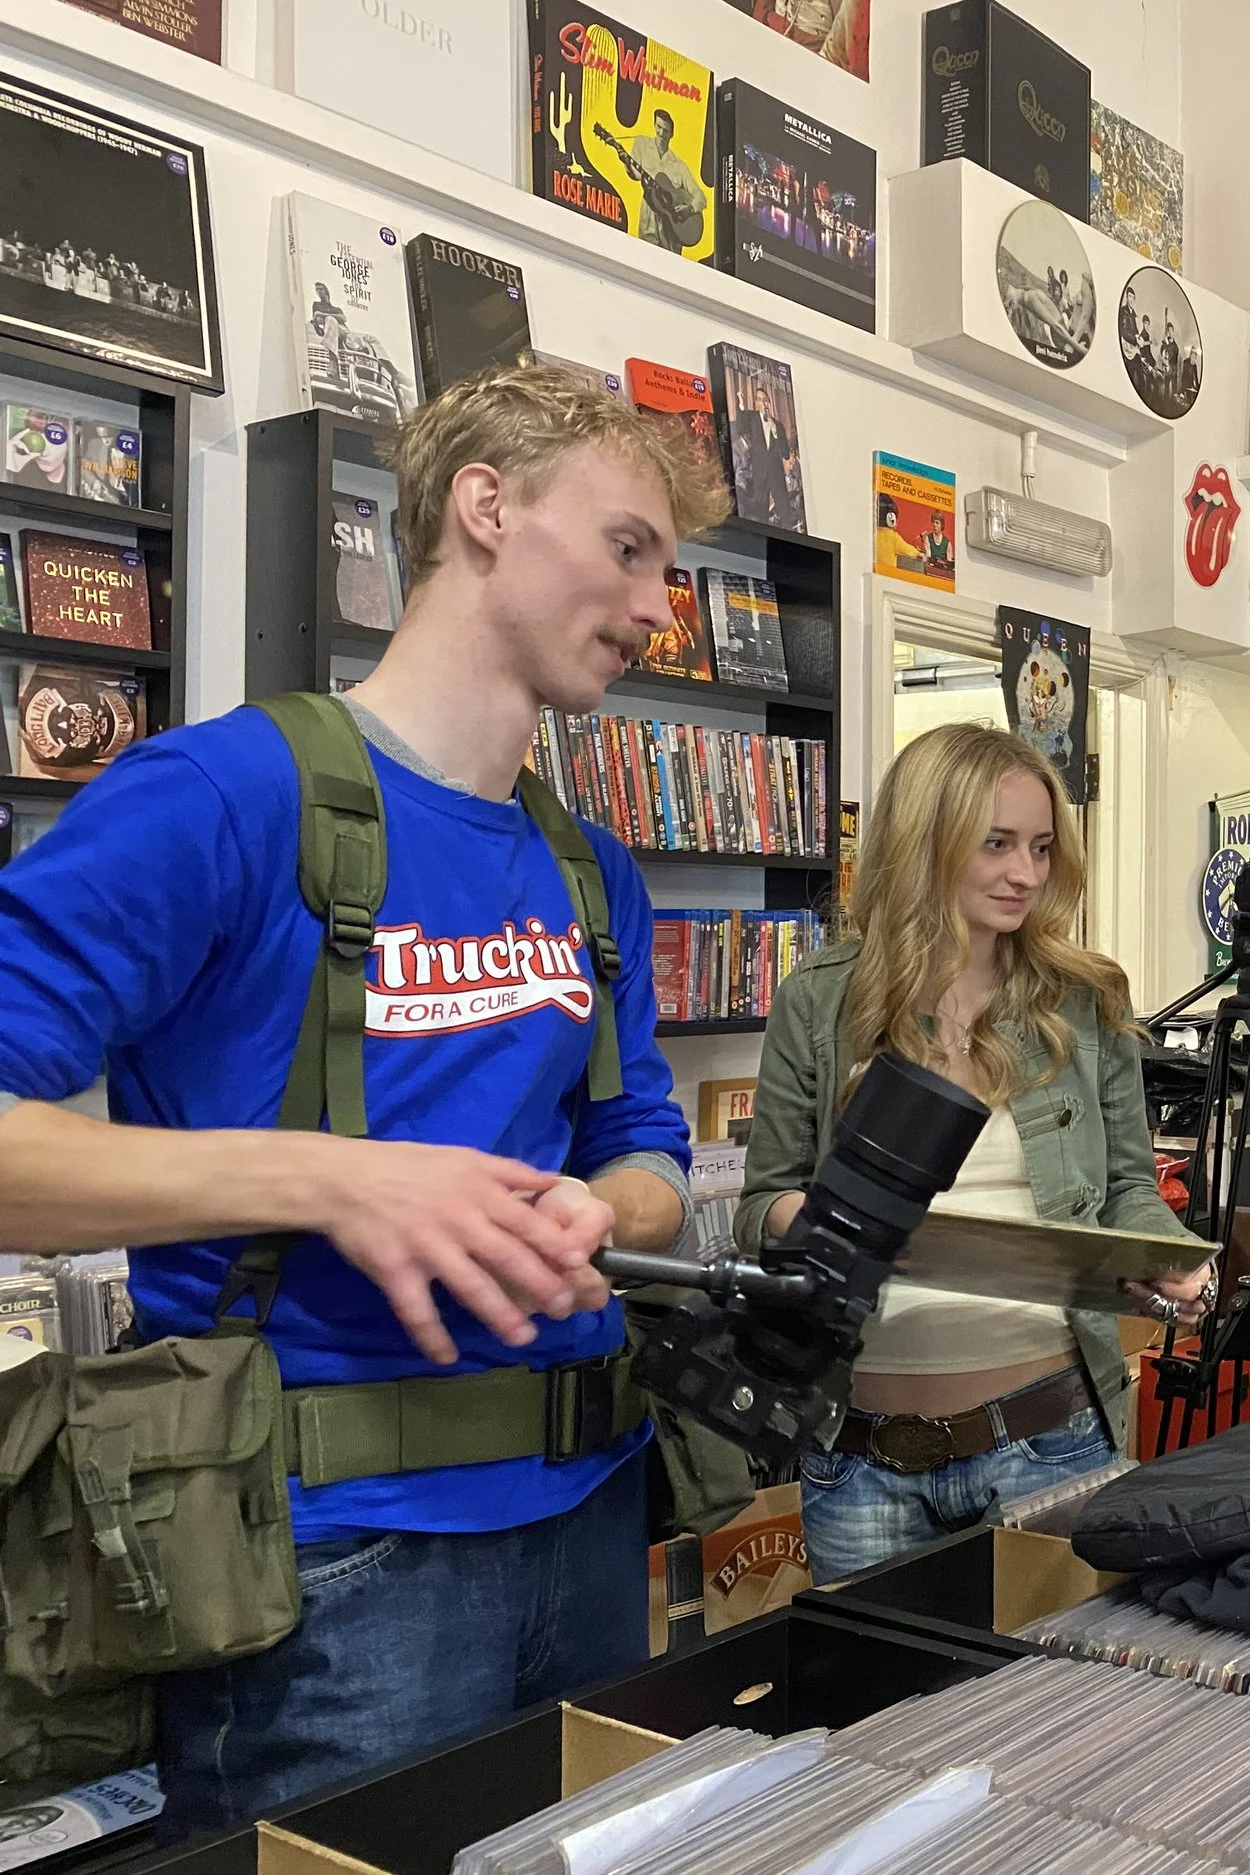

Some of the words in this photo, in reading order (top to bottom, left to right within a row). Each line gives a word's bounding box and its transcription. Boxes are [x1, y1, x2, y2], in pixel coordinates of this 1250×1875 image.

[122, 8, 141, 23] BEN
[142, 15, 187, 41] WEBSTER
[123, 0, 153, 17] ALVIN
[154, 11, 193, 34] STOLLER
[360, 0, 452, 55] OLDER
[559, 22, 615, 77] Slim
[617, 37, 703, 103] Whitman
[784, 113, 832, 145] METALLICA
[553, 170, 583, 208] ROSE
[586, 184, 622, 222] MARIE
[330, 254, 371, 279] GEORGE
[430, 239, 522, 289] HOOKER
[343, 283, 372, 302] SPIRIT
[645, 380, 679, 395] Anthems
[50, 431, 62, 441] £6
[121, 441, 134, 451] £4
[881, 479, 901, 492] TAPES
[902, 486, 917, 497] AND
[917, 490, 953, 507] CASSETTES
[43, 560, 134, 588] QUICKEN
[71, 585, 111, 606] THE
[59, 605, 124, 628] HEART
[1004, 620, 1089, 656] QUEEN
[1212, 858, 1244, 887] PREMIU
[384, 1003, 445, 1023] FOR
[448, 1000, 463, 1019] A
[469, 990, 519, 1014] CURE
[719, 1533, 807, 1589] BAILEYS
